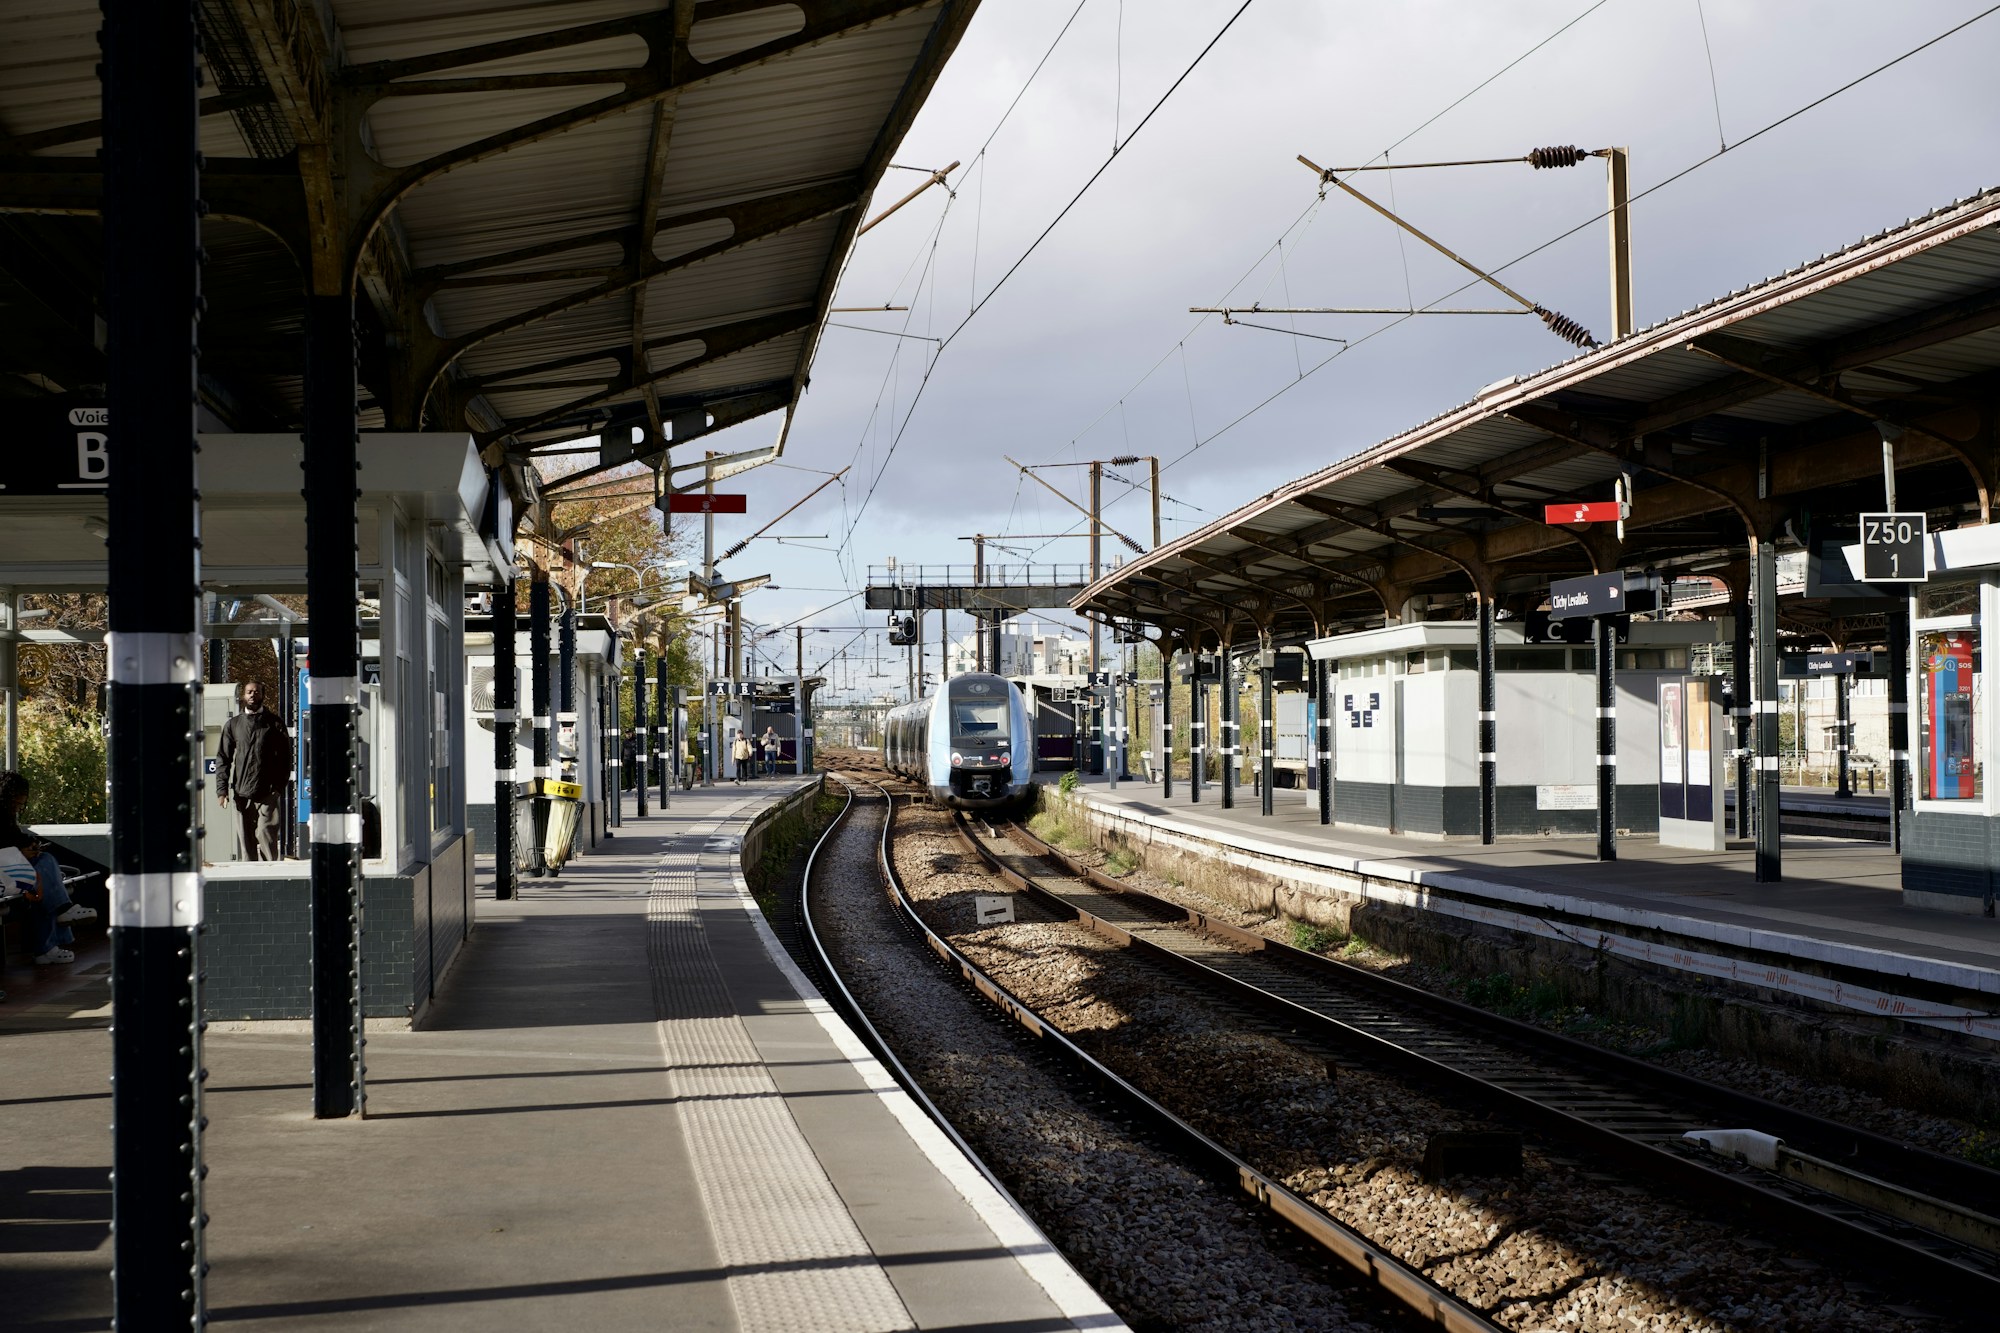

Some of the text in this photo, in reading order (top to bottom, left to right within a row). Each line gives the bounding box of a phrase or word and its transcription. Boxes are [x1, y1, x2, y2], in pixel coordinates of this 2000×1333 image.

[74, 410, 109, 423] Voie
[77, 432, 110, 480] B
[1890, 553, 1899, 573] 1
[1553, 592, 1589, 610] Clichy Levallois
[1547, 622, 1564, 640] C
[717, 685, 724, 694] A
[741, 685, 749, 694] B
